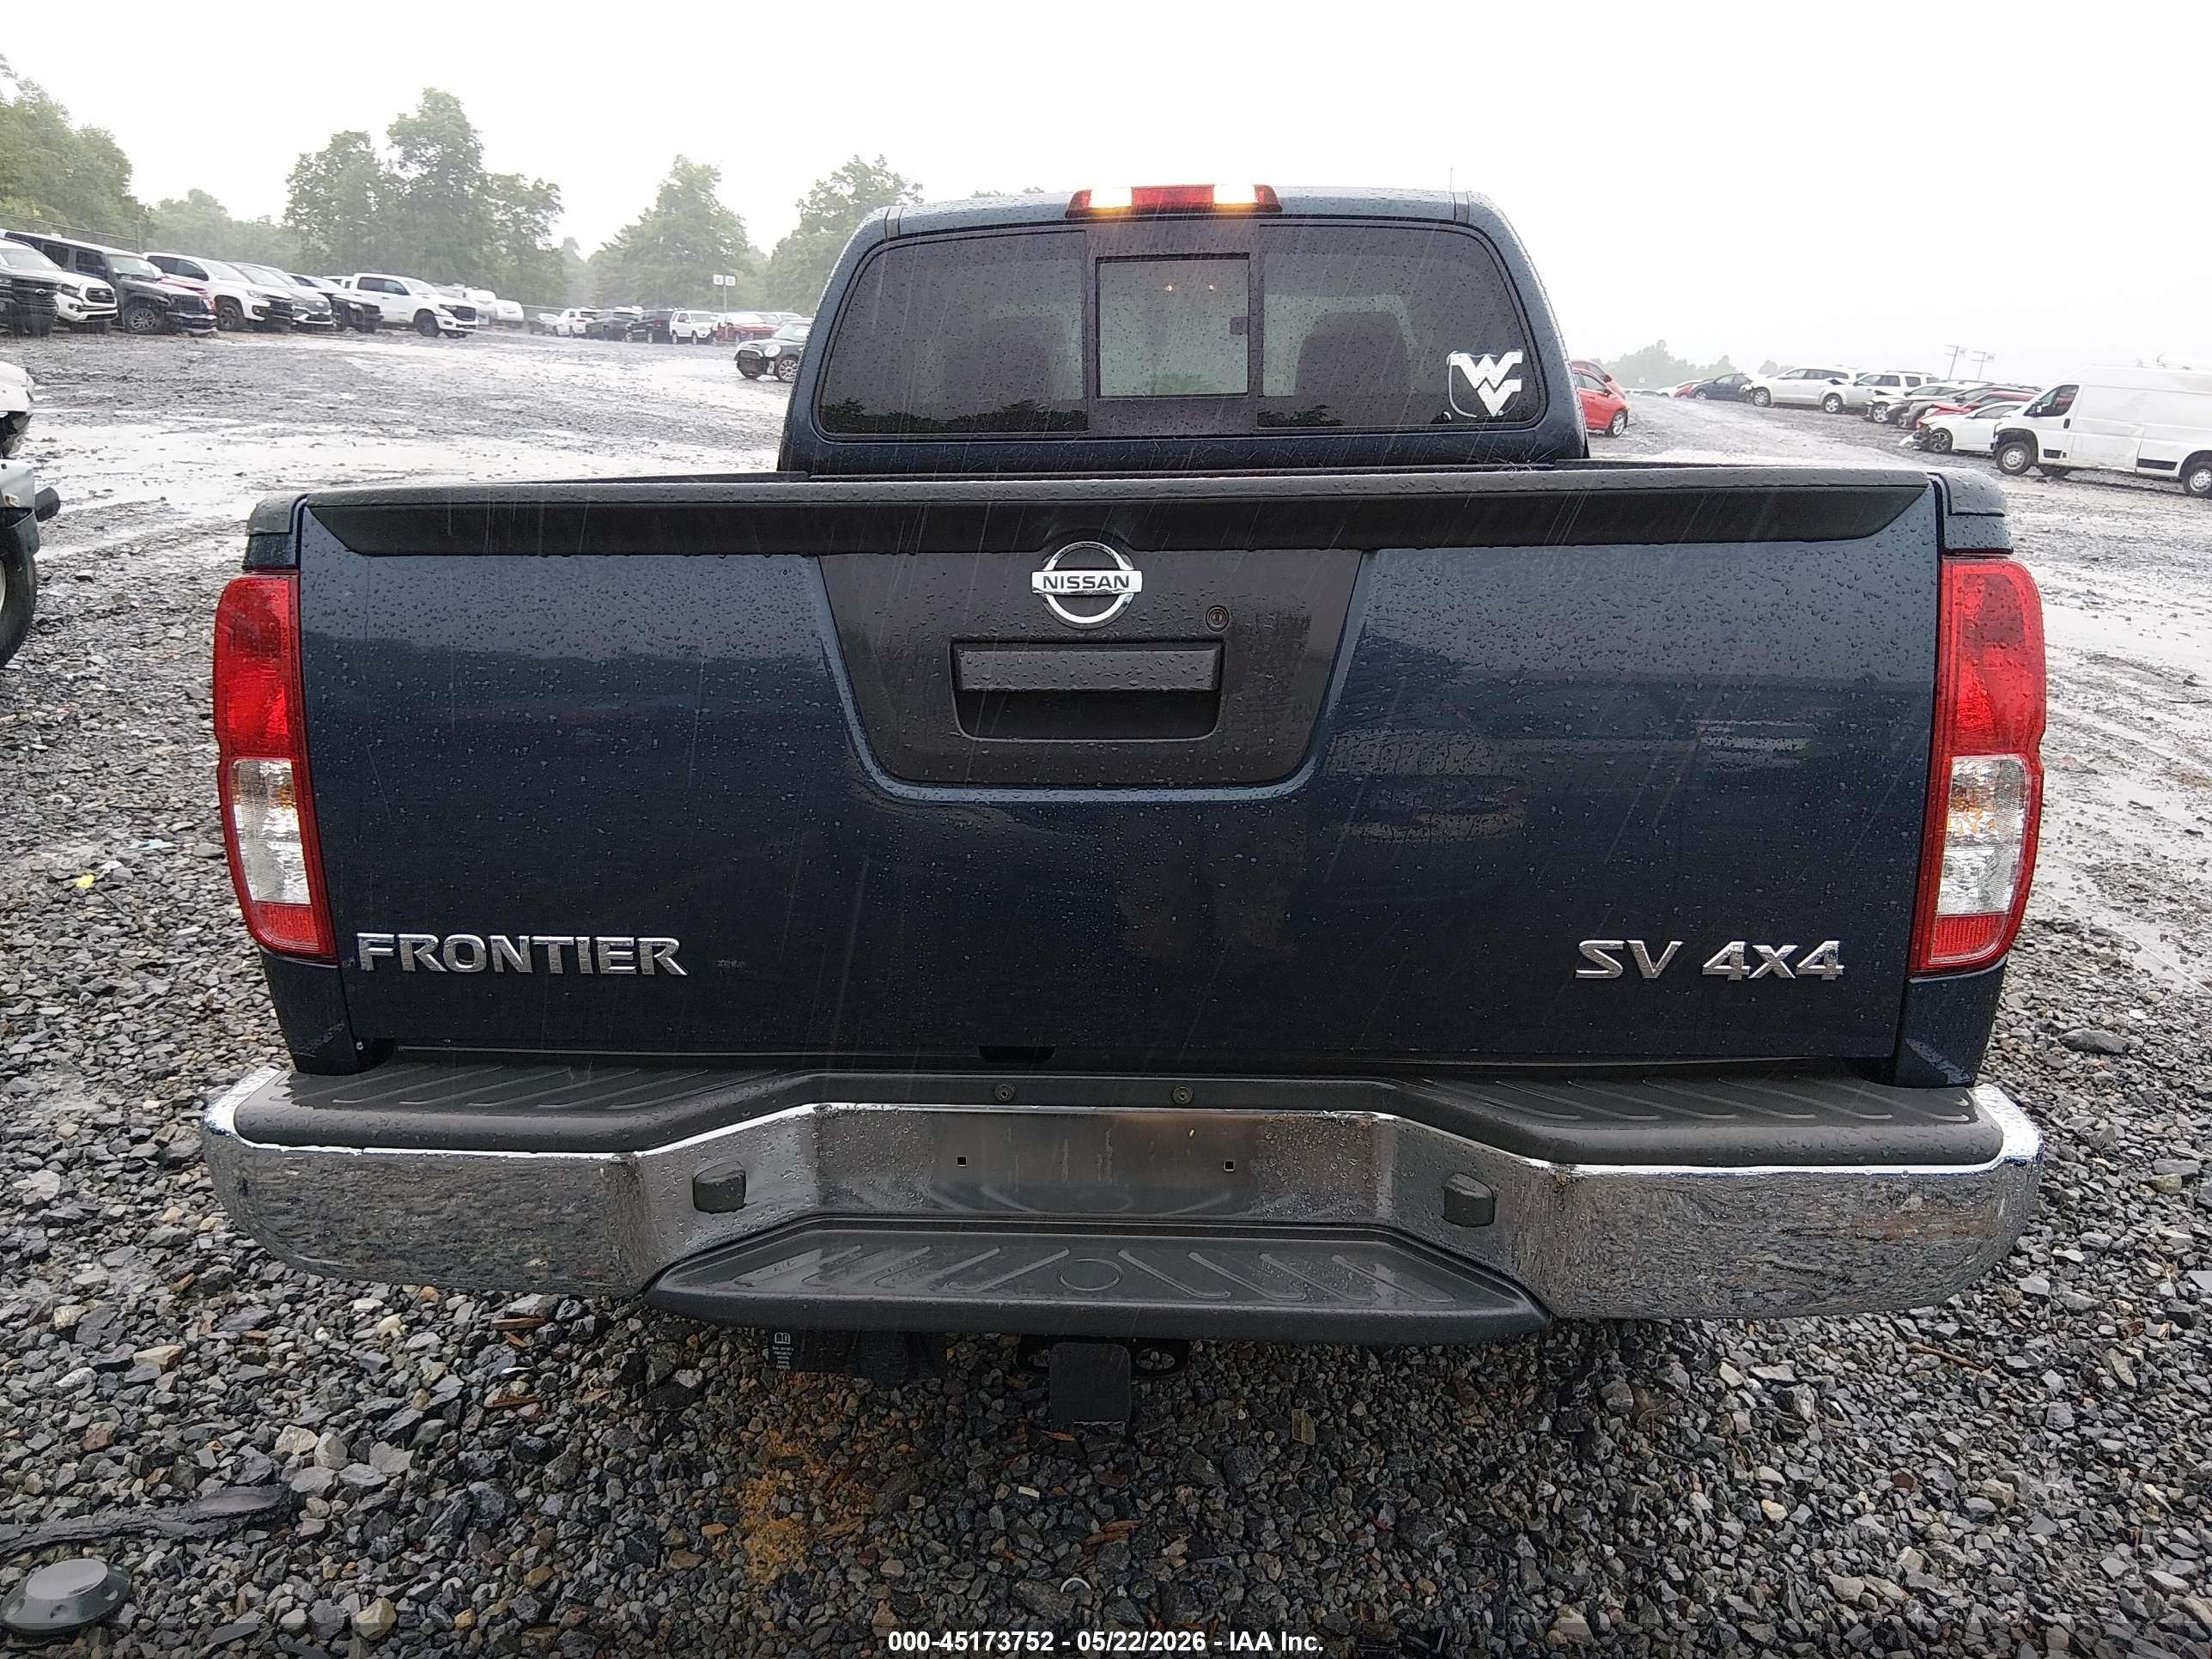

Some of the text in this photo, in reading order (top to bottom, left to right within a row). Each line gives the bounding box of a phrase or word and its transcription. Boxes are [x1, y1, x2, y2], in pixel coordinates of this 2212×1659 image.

[1042, 574, 1130, 590] NISSAN
[356, 932, 689, 976] FRONTIER
[1575, 939, 1683, 980] SV
